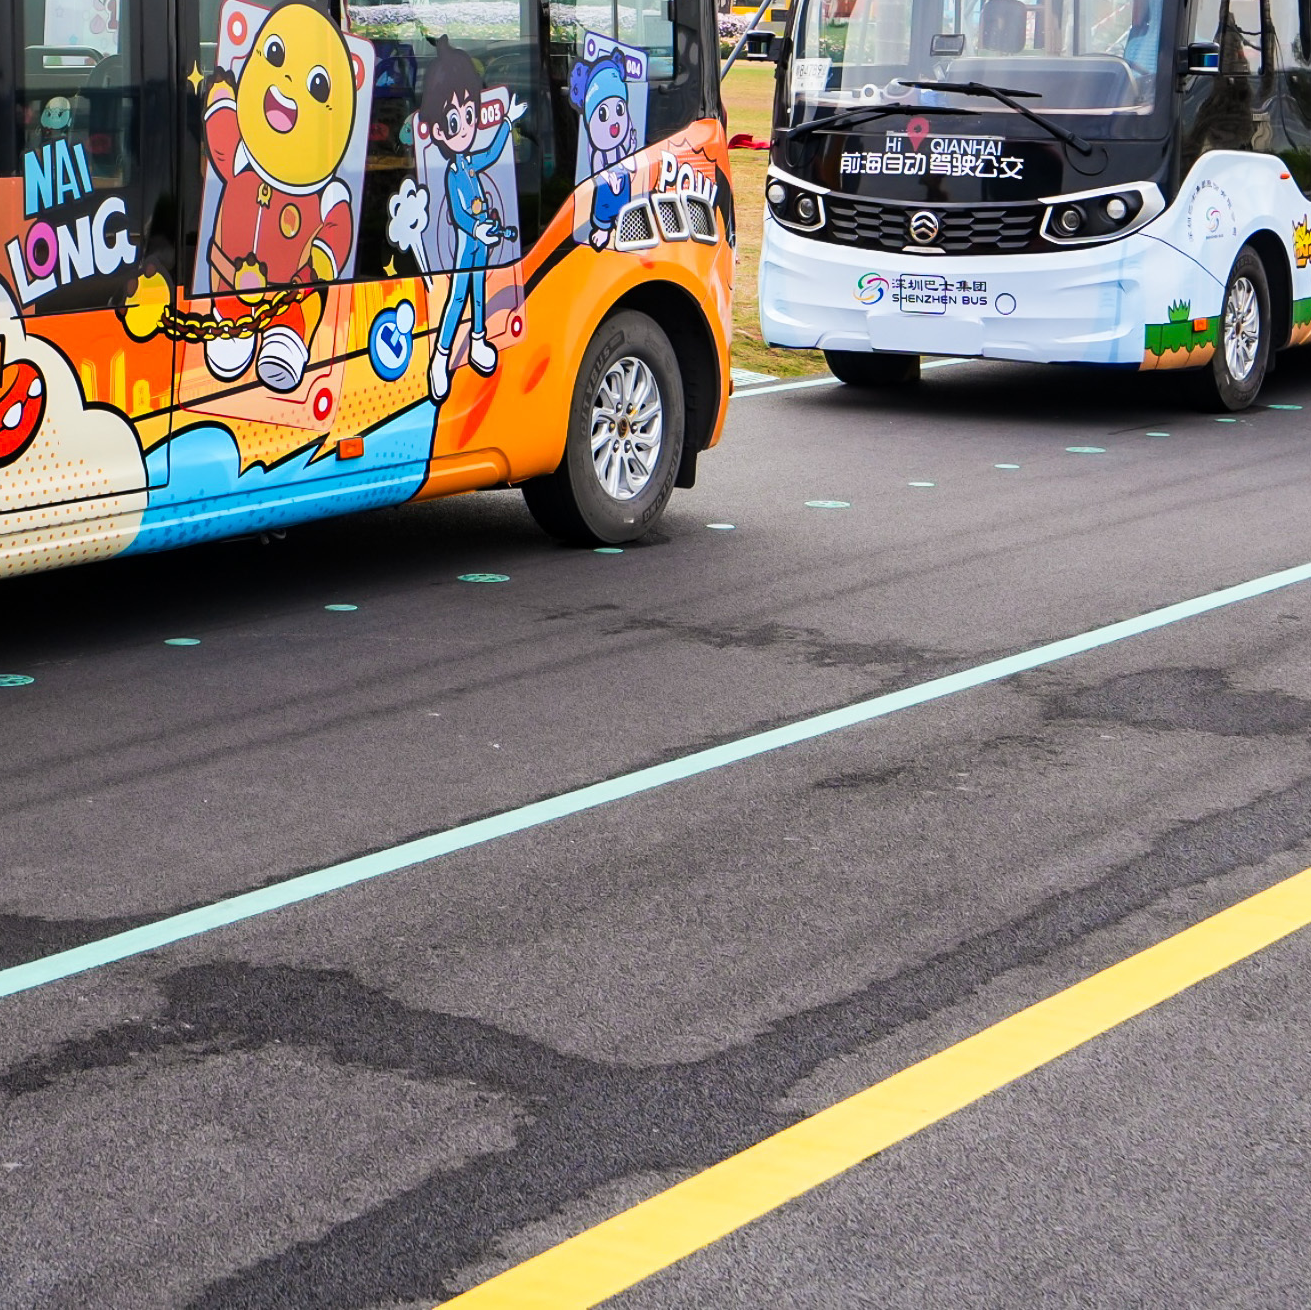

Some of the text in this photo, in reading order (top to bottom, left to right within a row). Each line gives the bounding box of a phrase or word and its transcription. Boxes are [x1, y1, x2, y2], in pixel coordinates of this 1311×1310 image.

[626, 59, 641, 76] 004
[480, 103, 501, 124] 003
[885, 137, 1002, 156] Hi QIANHAI
[840, 152, 1024, 180] 前海自动驾驶公交
[25, 139, 92, 216] NAI
[7, 197, 137, 305] LONG
[891, 278, 987, 293] 深圳巴士集团
[892, 293, 988, 306] SHENZHEN BUS
